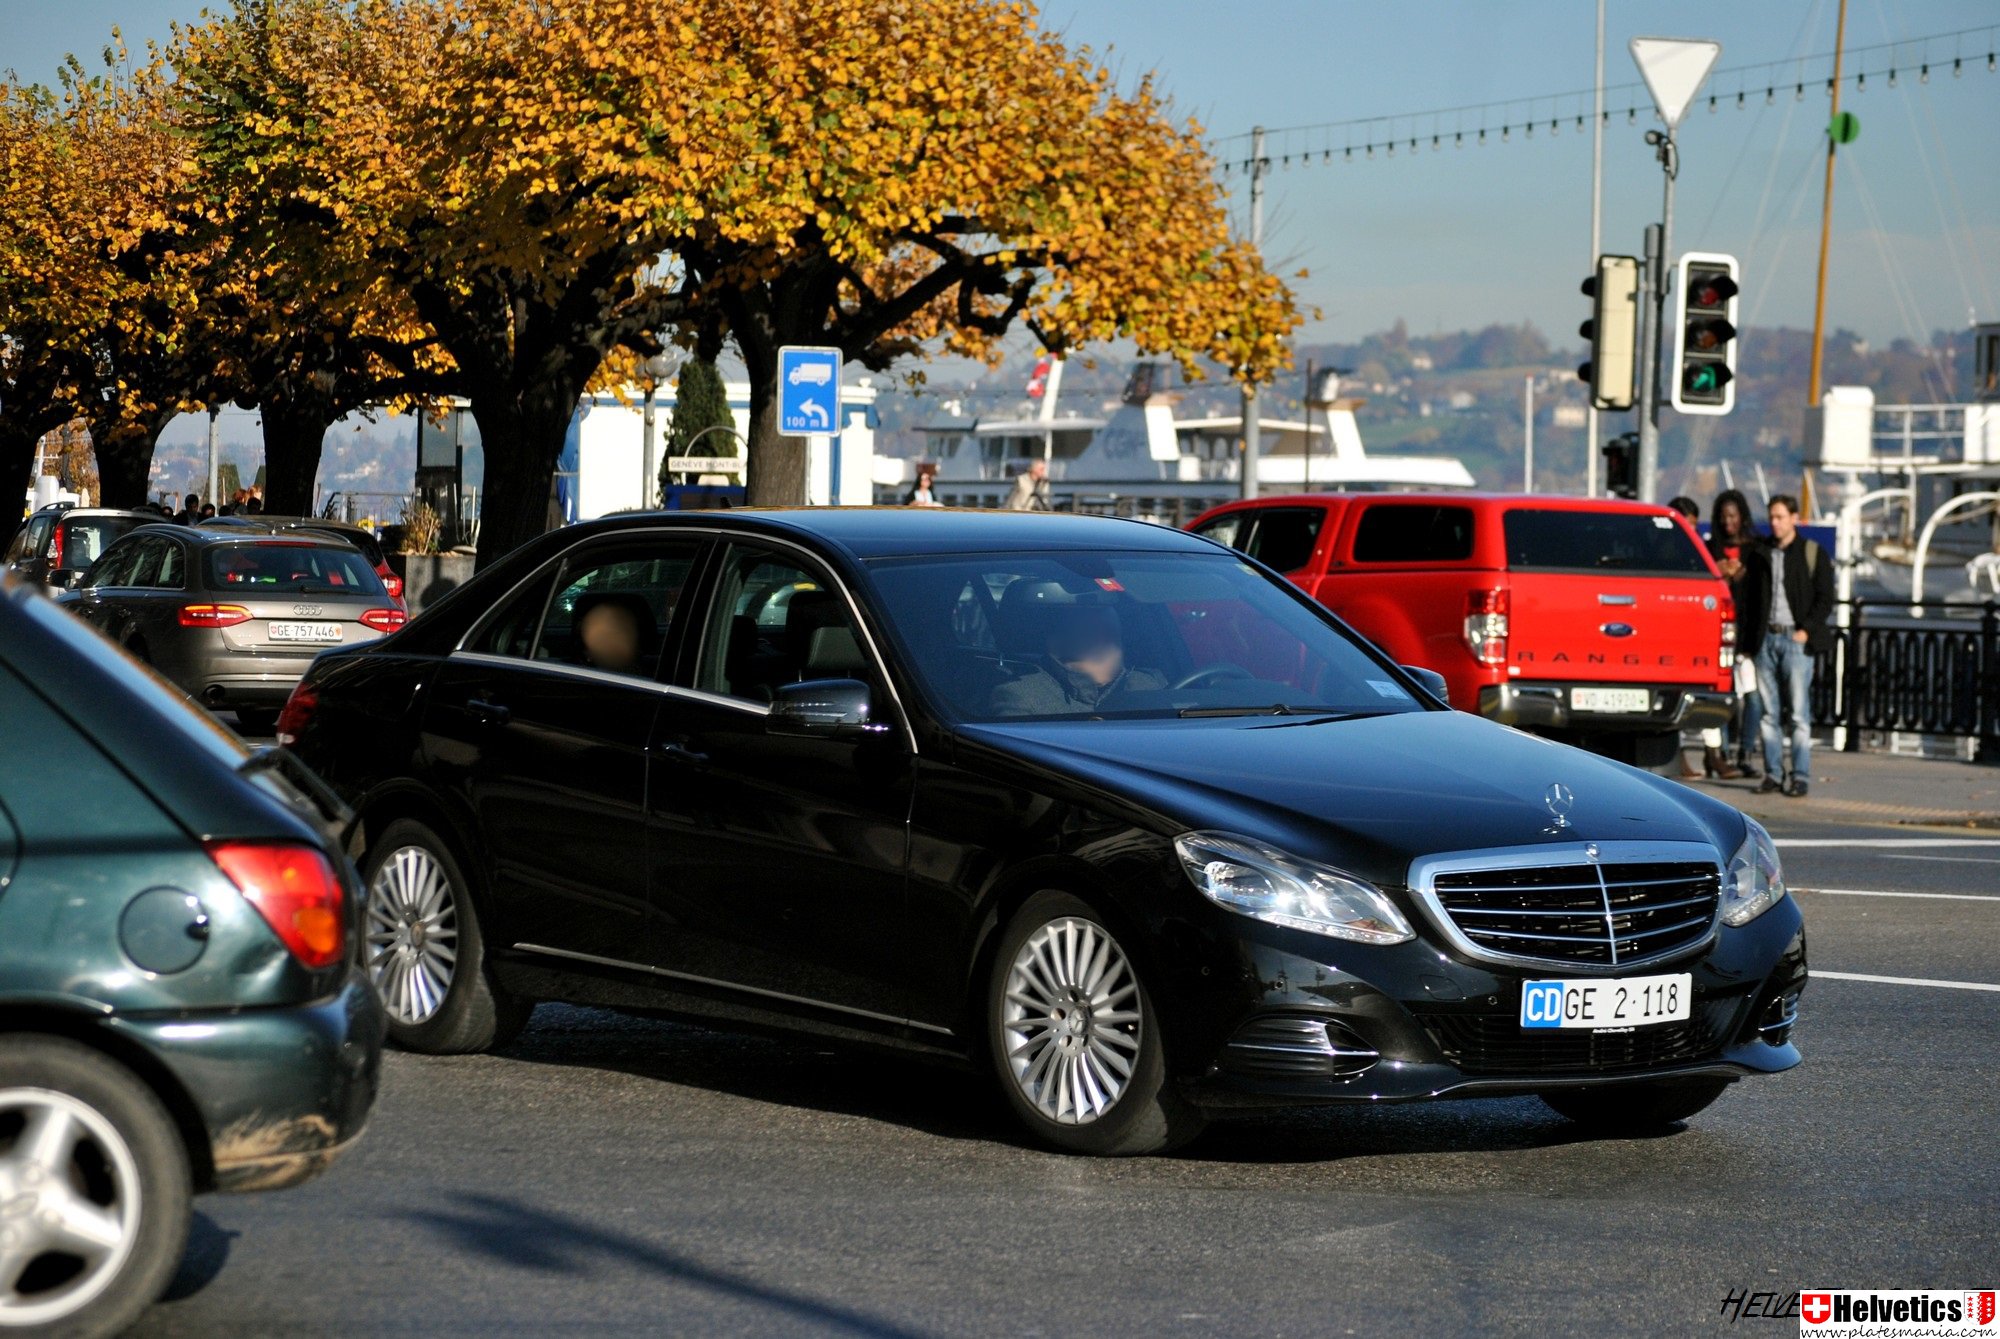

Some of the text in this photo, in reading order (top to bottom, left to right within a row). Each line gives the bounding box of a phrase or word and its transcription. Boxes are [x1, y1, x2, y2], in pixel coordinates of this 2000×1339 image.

[786, 416, 820, 428] 100 m
[1517, 651, 1710, 667] RANGER
[1526, 987, 1562, 1022] CD
[1565, 987, 1597, 1020] GE
